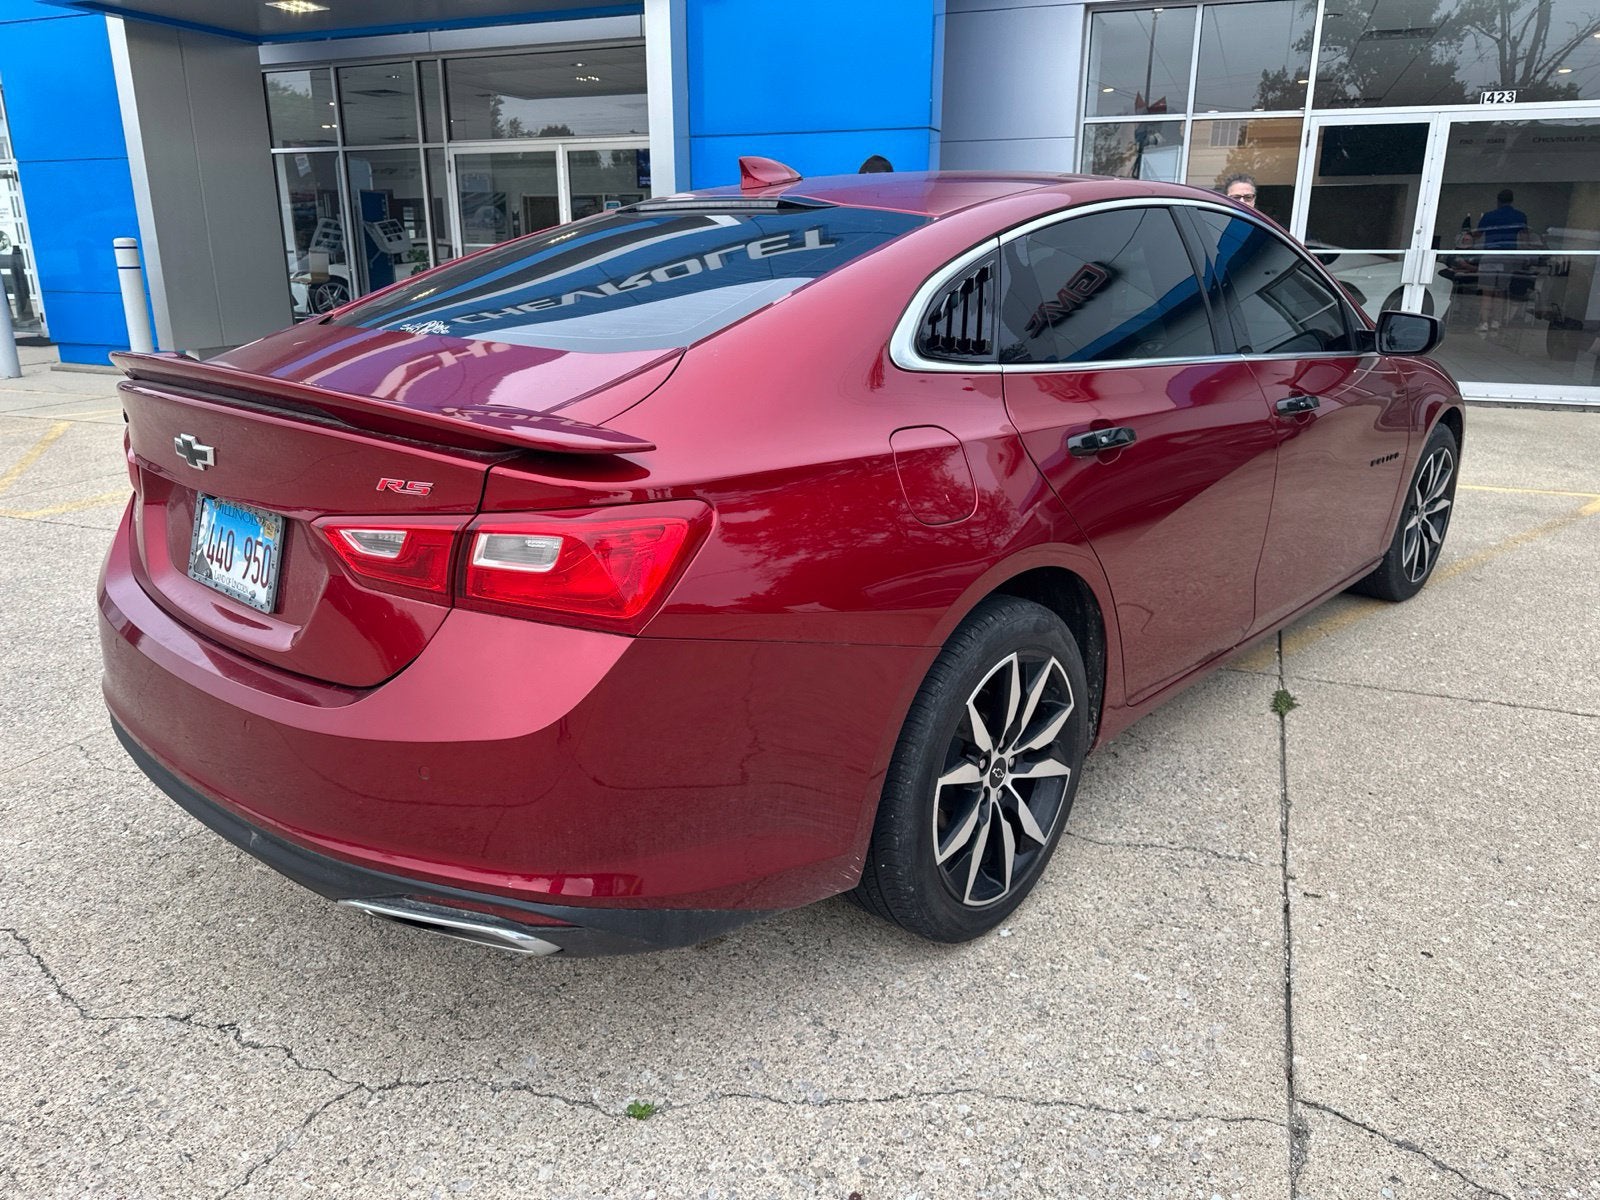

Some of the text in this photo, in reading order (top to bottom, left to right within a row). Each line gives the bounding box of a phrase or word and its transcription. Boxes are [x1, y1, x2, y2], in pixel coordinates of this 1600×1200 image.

[1481, 91, 1515, 104] 1423
[376, 477, 434, 496] RS
[219, 503, 260, 527] ILLINOIS
[206, 523, 272, 588] 440 950
